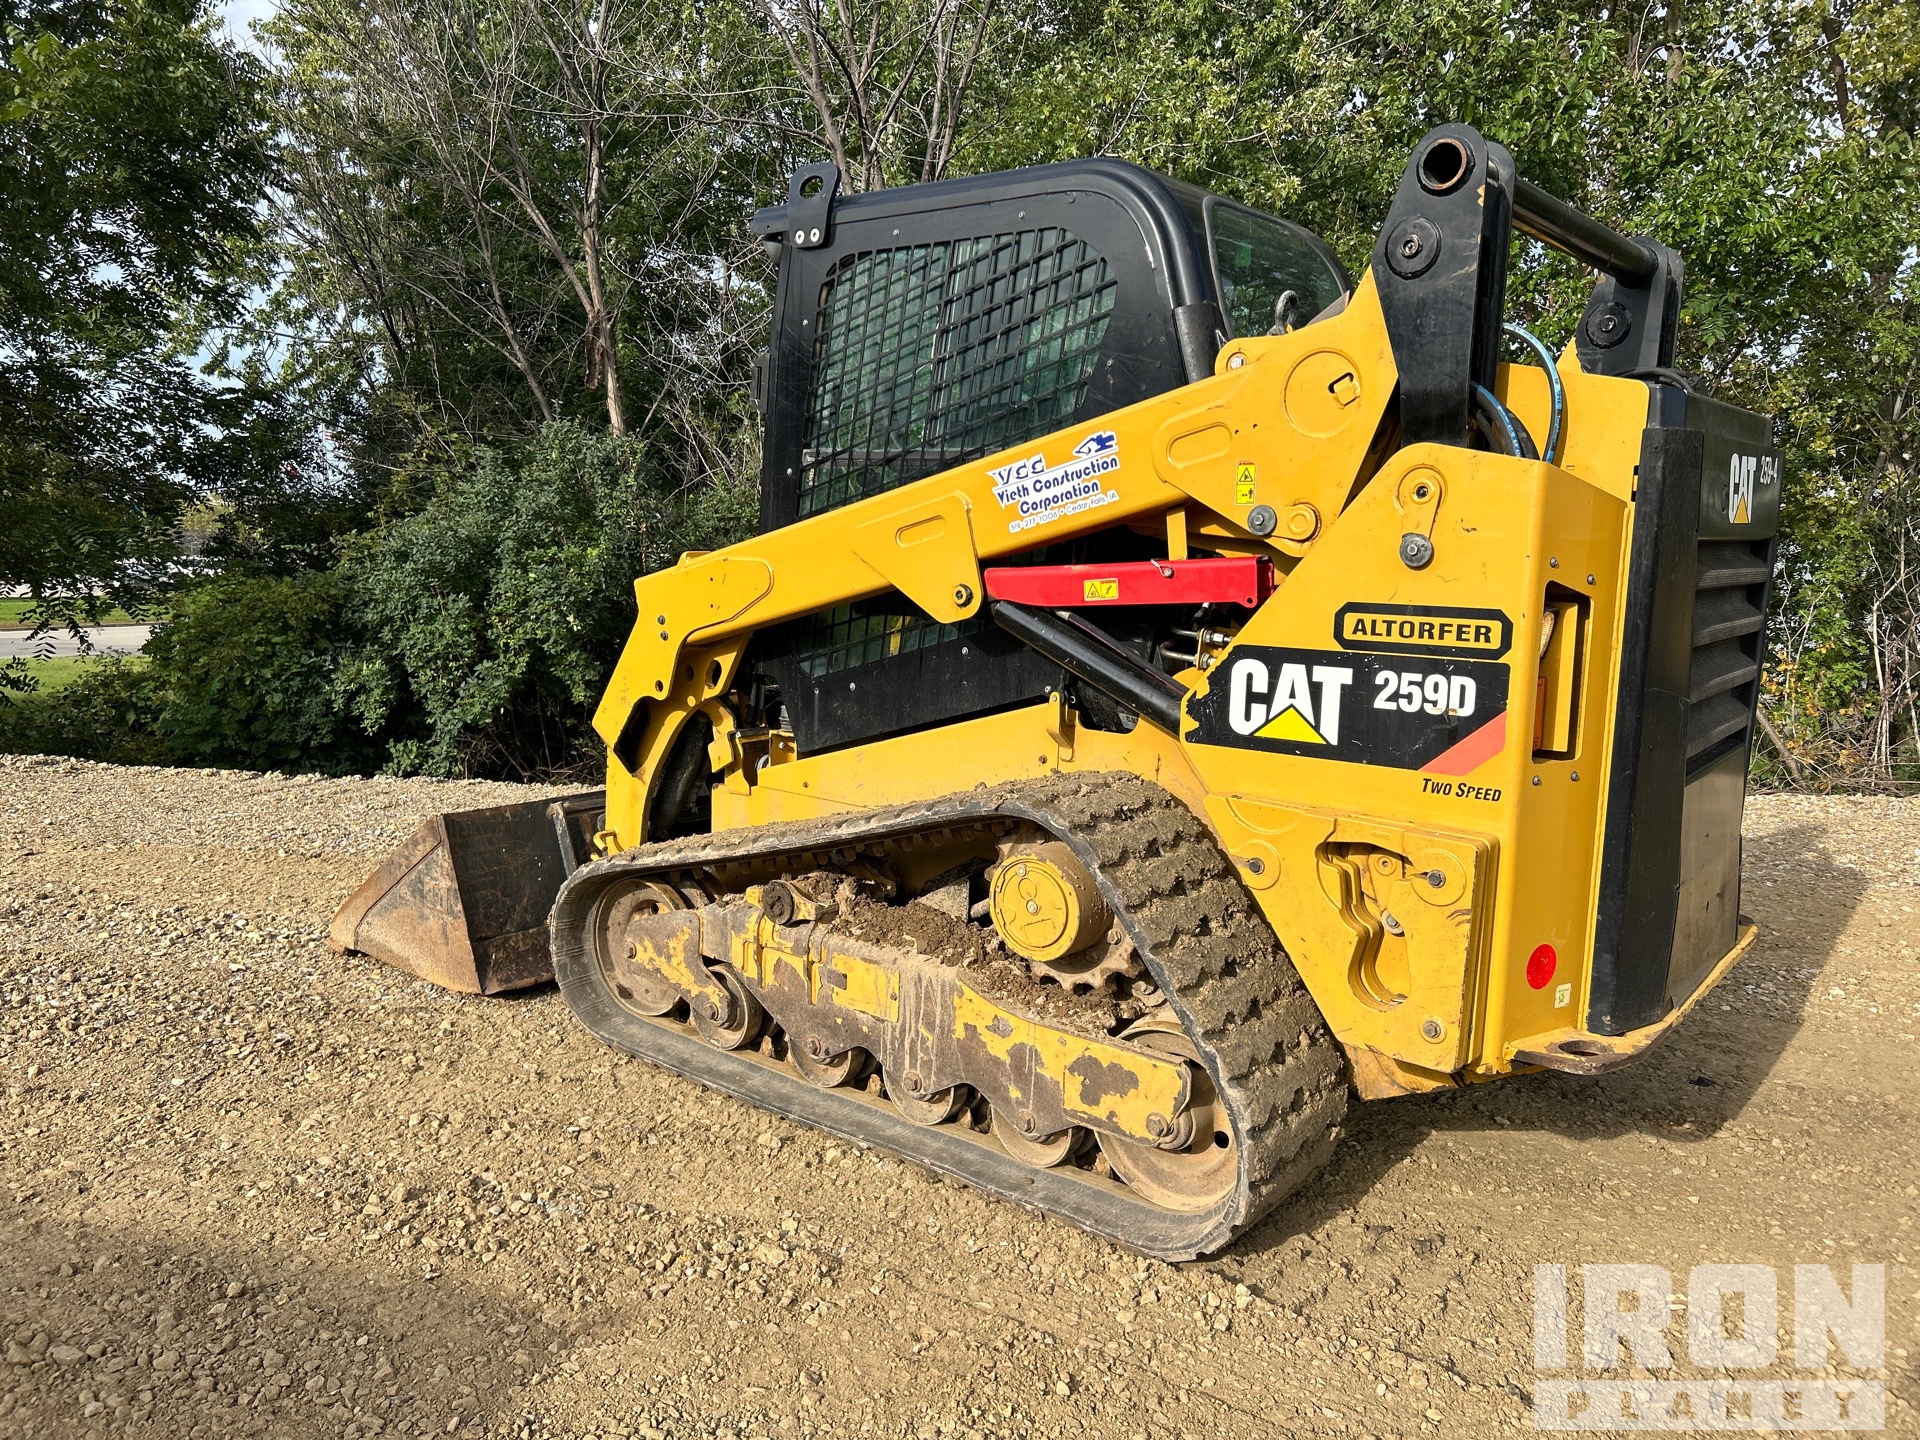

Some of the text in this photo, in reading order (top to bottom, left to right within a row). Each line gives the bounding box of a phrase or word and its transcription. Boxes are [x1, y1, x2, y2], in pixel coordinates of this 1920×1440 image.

[993, 456, 1045, 486] VCC
[997, 456, 1118, 504] Vieth Construction
[1729, 453, 1757, 524] CAT
[1020, 481, 1099, 514] Corporation
[1351, 618, 1492, 643] ALTORFER
[1228, 658, 1477, 746] CAT 259D
